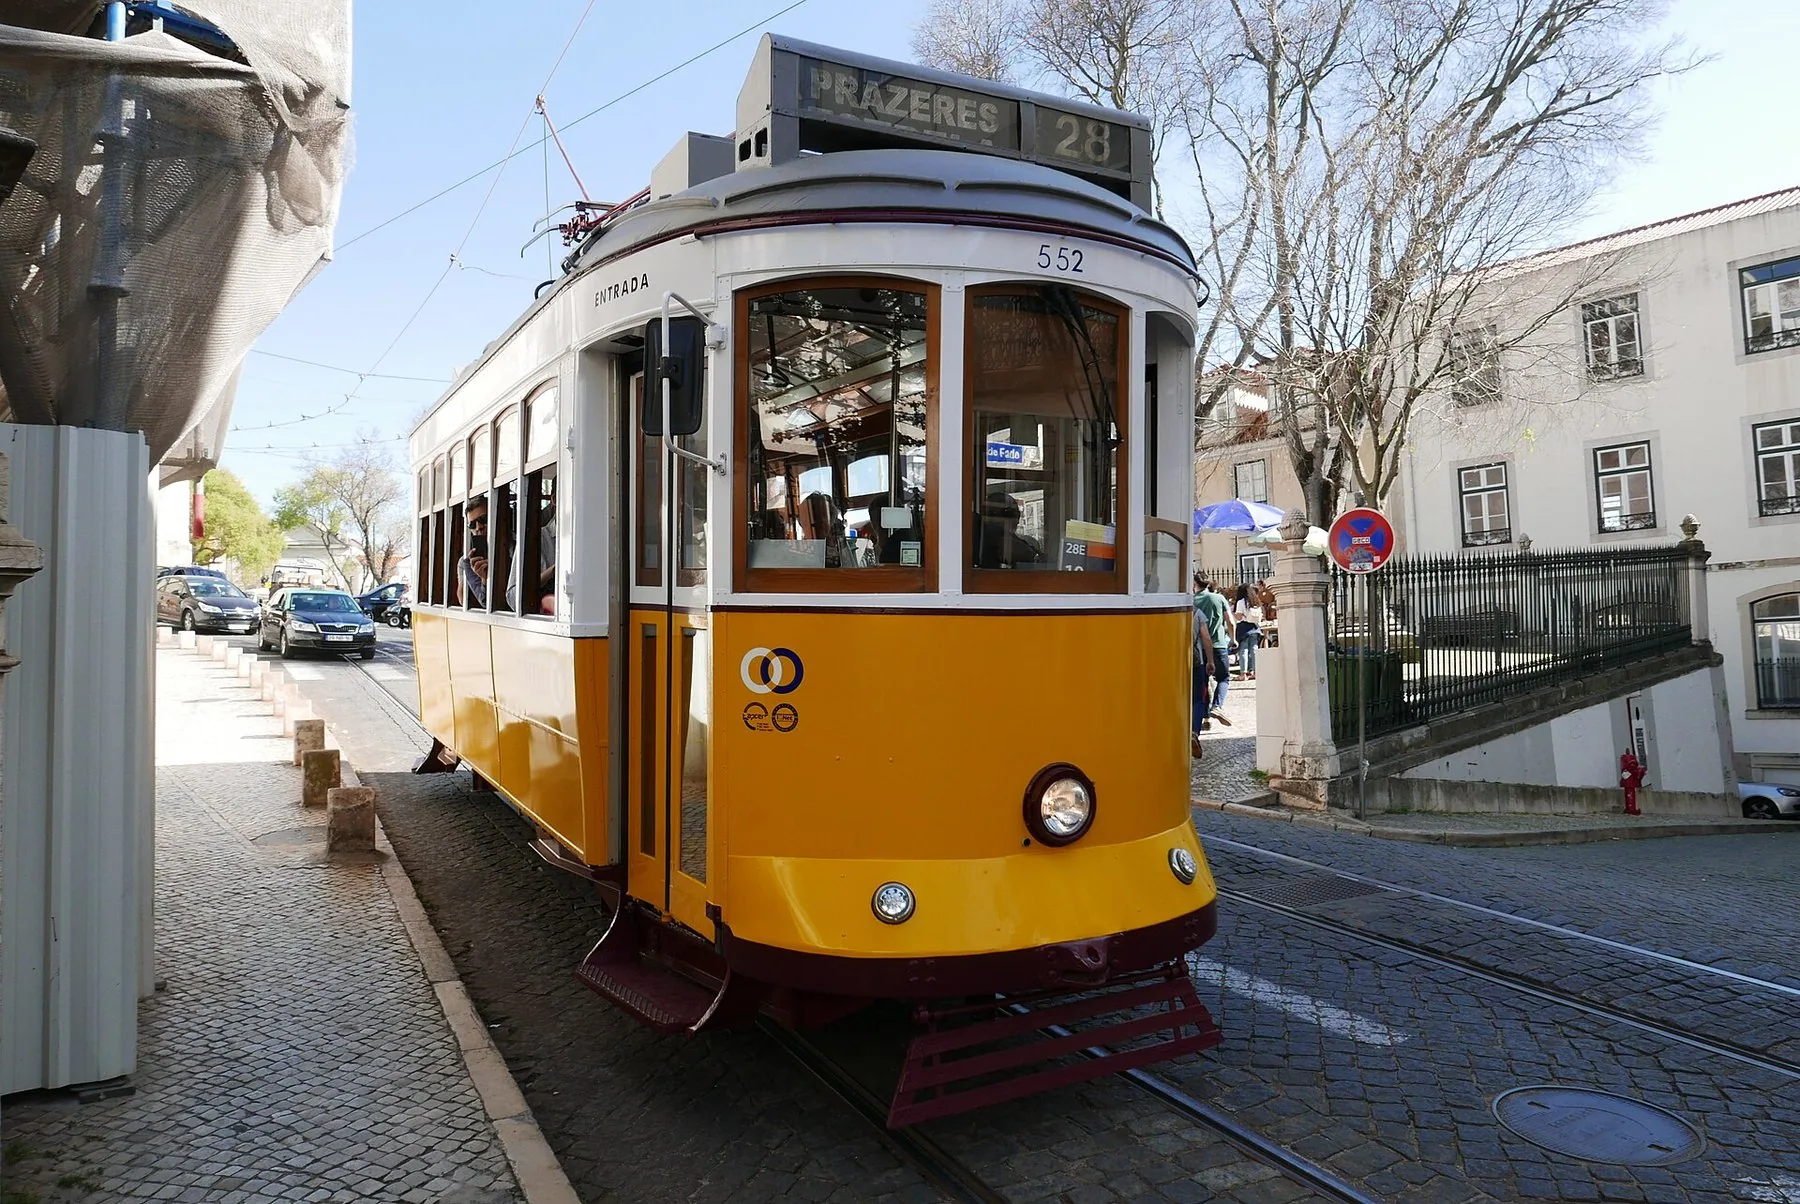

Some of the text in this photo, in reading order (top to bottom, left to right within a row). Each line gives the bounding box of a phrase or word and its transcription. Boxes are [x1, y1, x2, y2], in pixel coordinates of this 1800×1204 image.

[810, 67, 1000, 134] PRAZERES
[1055, 115, 1111, 163] 28
[1037, 244, 1084, 273] 552
[594, 272, 649, 308] ENTRADA
[1065, 542, 1086, 556] 28E
